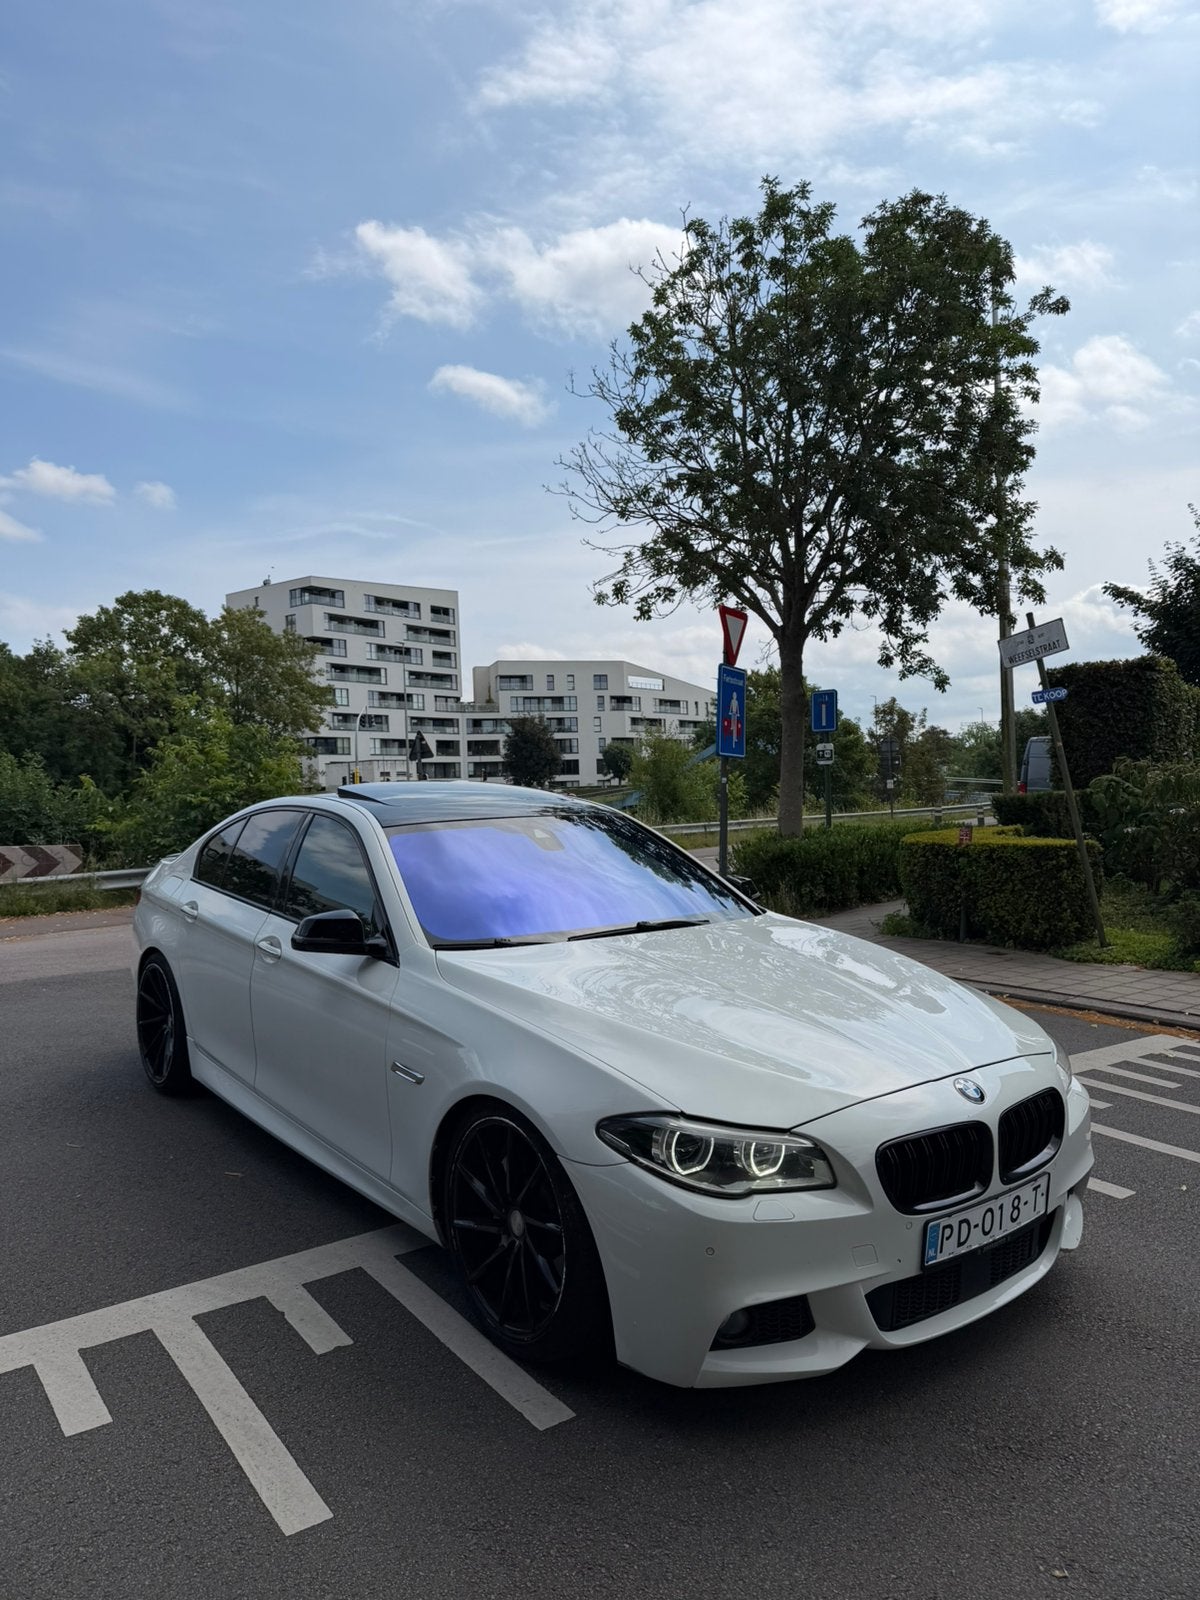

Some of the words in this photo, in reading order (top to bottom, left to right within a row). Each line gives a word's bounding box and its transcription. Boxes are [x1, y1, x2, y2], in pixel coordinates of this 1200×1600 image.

[1008, 640, 1060, 664] WEEFSELSTRAAT
[1033, 693, 1043, 702] TE
[1044, 689, 1067, 700] KOOP
[939, 1184, 1041, 1254] PD-018-T
[928, 1248, 937, 1258] NL
